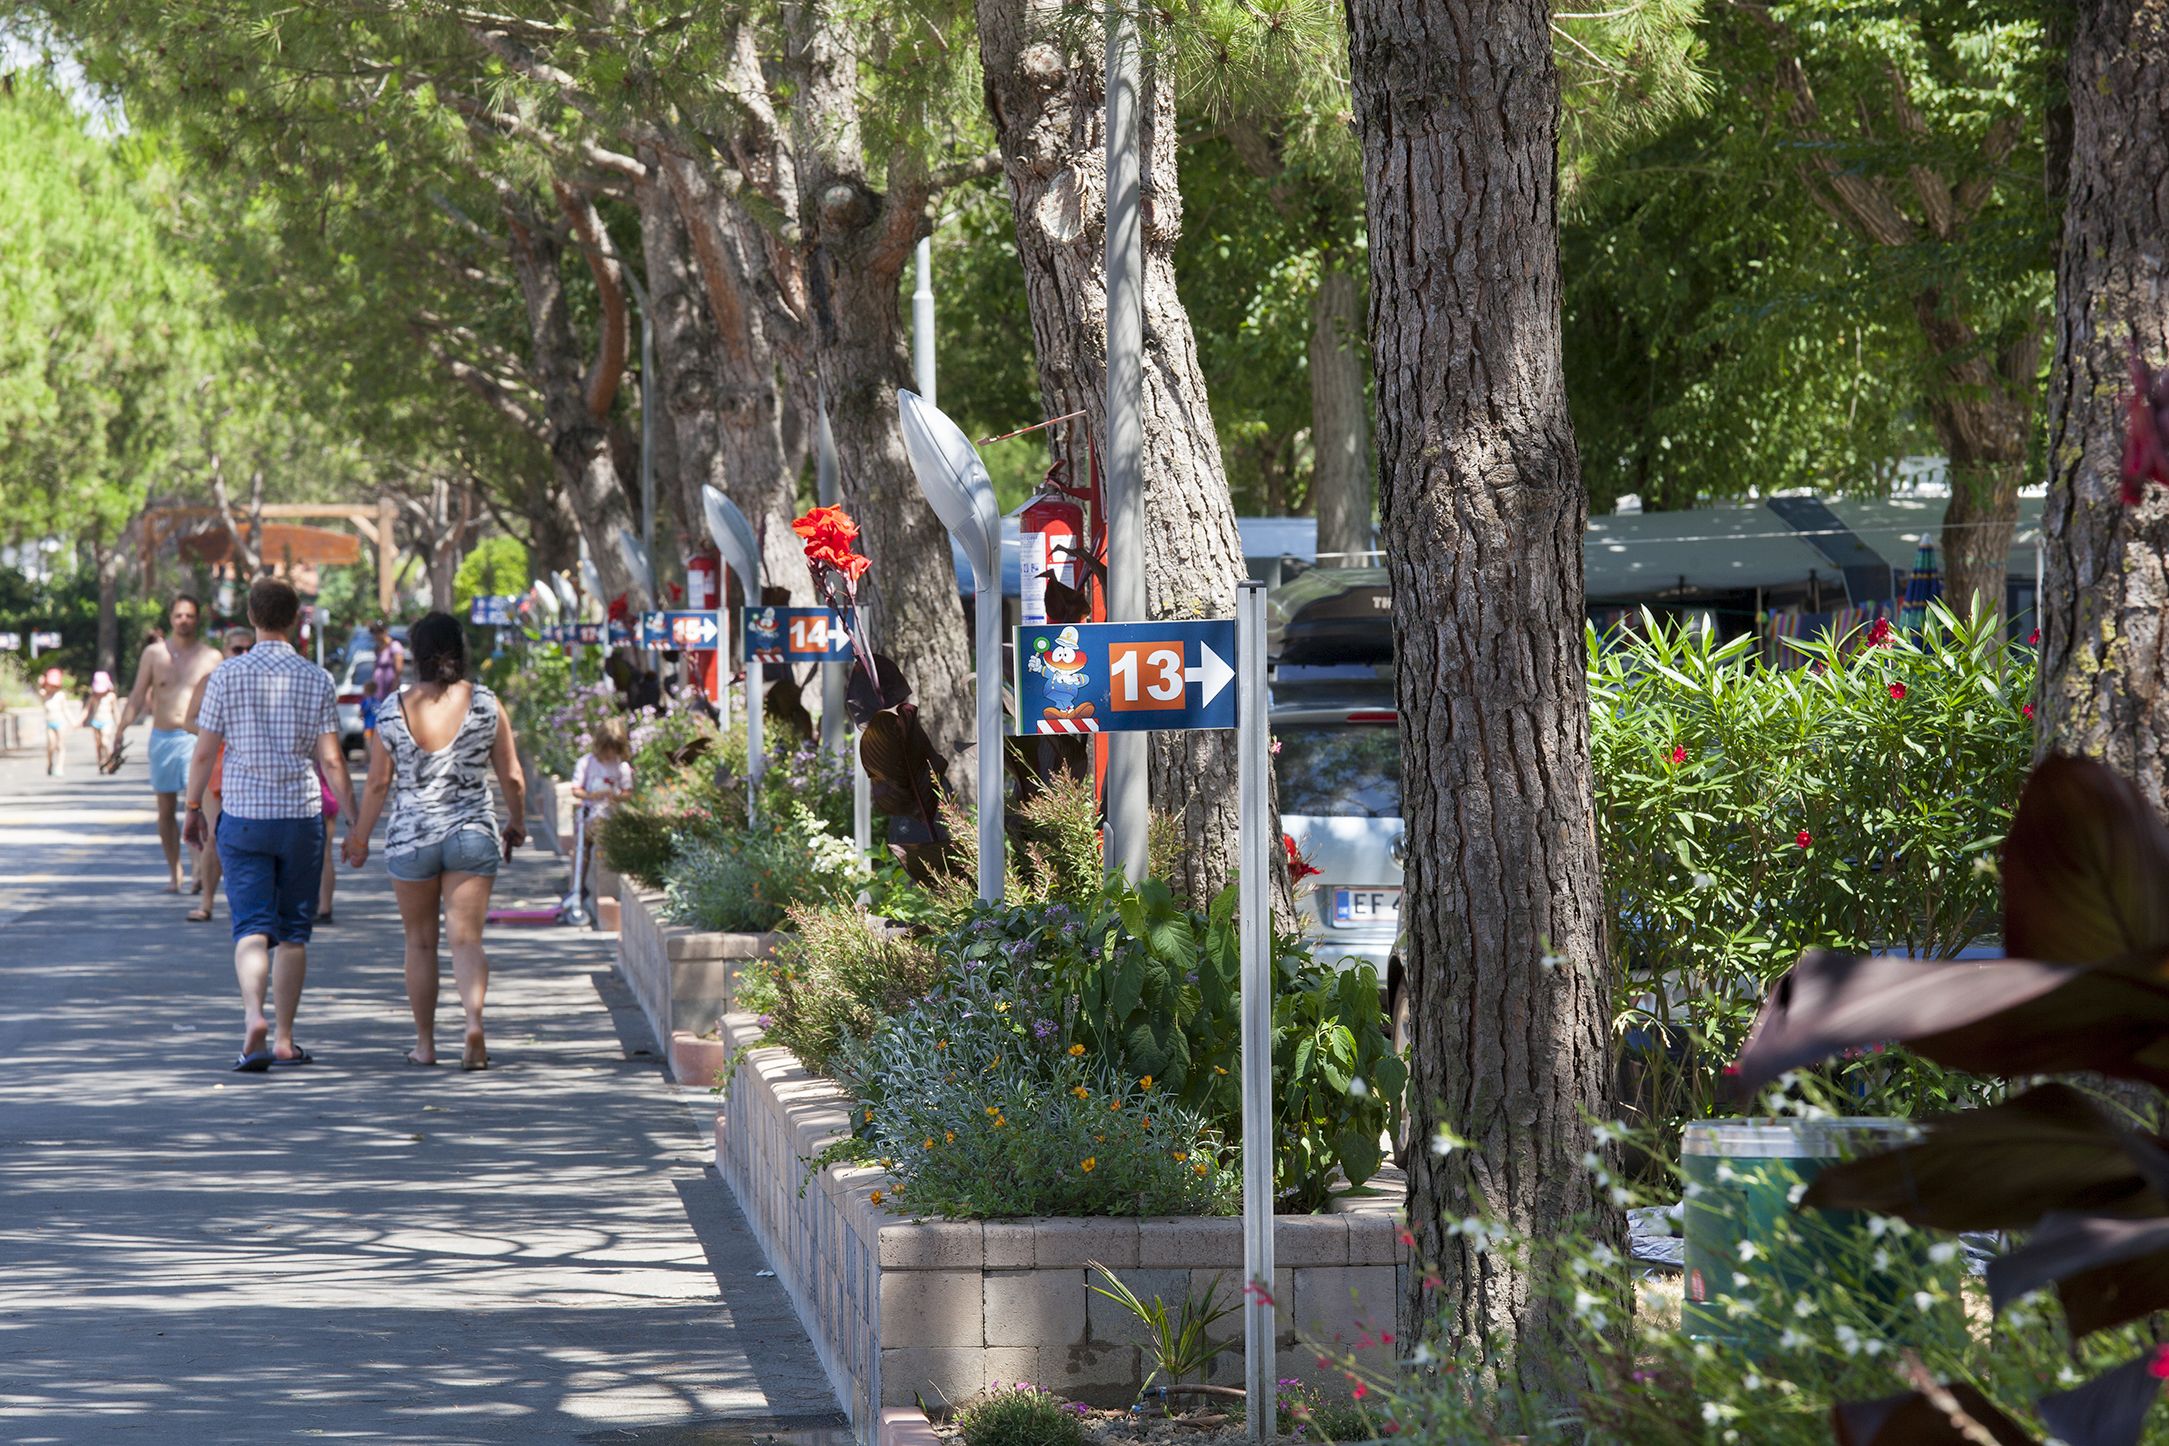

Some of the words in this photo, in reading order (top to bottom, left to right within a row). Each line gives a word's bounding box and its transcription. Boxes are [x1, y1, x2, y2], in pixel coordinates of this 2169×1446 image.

[790, 620, 828, 648] 14
[1111, 649, 1184, 701] 13
[1354, 893, 1384, 914] EF
